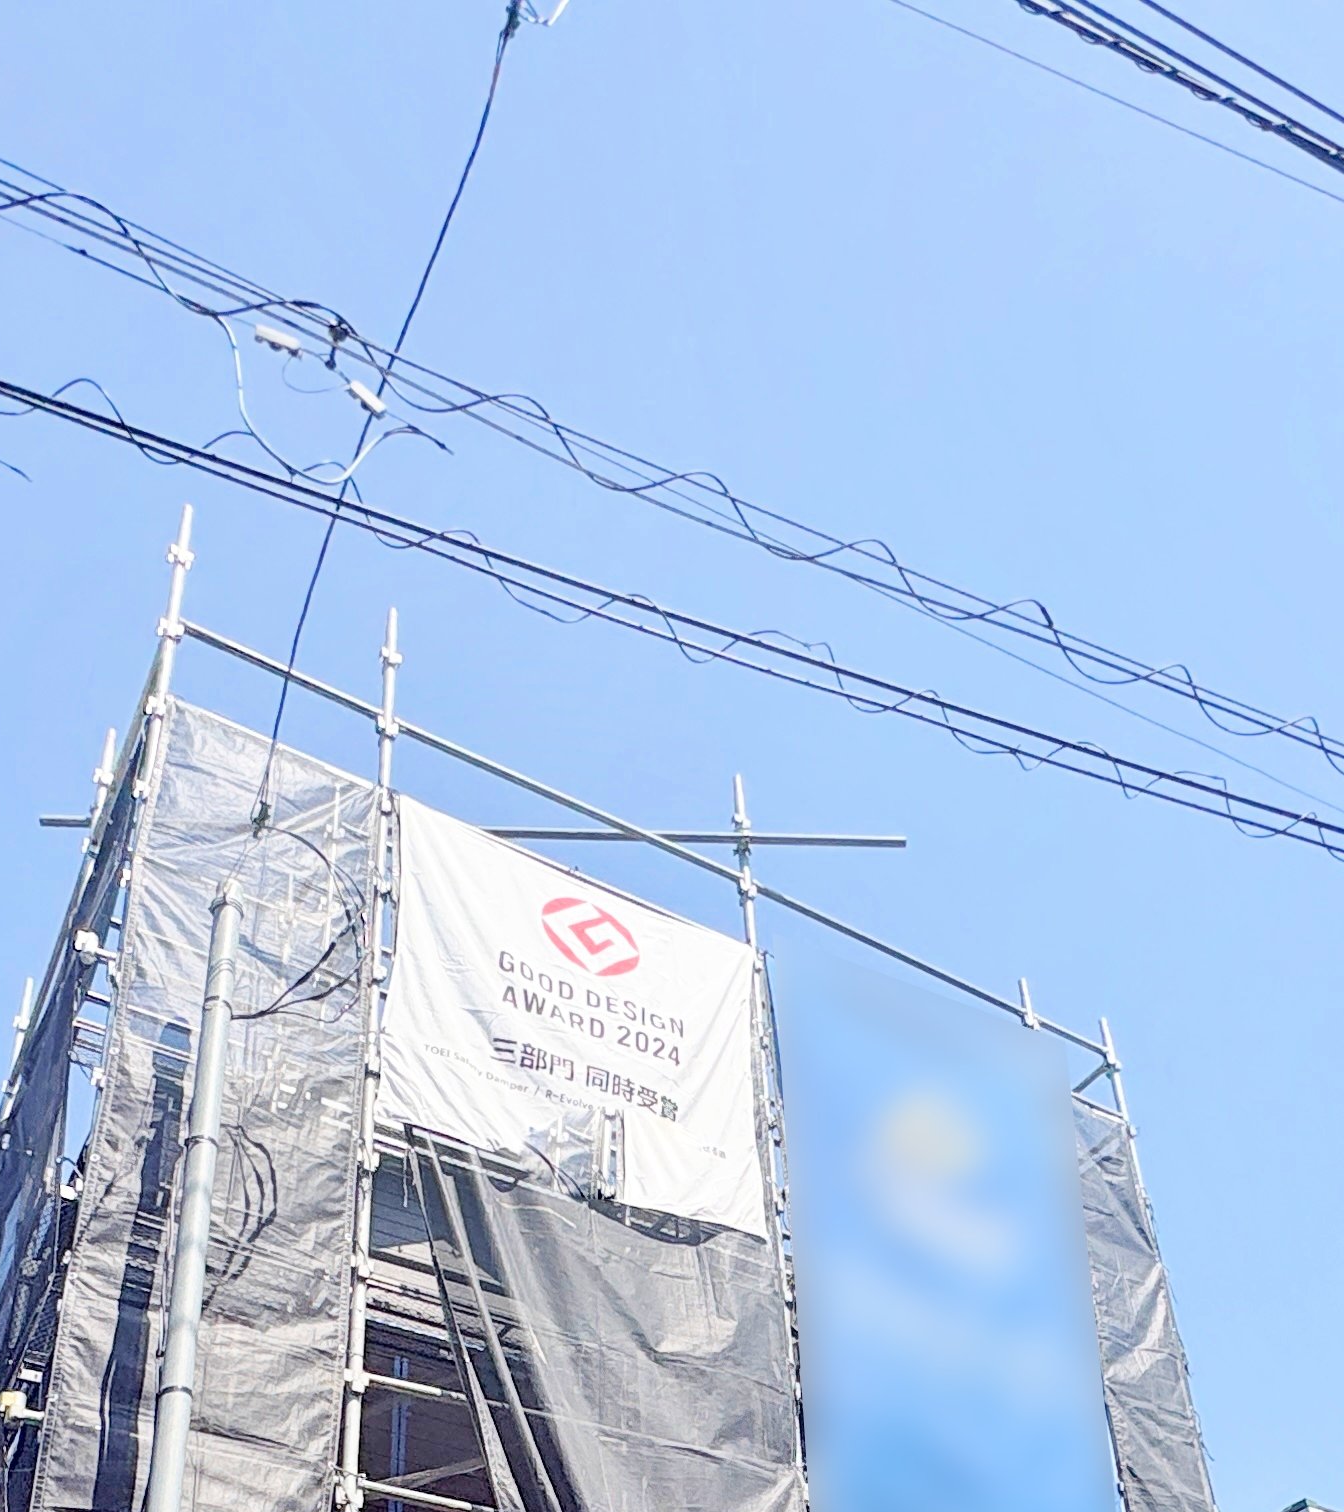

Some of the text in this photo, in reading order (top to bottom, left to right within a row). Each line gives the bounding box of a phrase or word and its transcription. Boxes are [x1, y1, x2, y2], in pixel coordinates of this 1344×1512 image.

[499, 950, 684, 1038] GOOD DESIGN
[502, 985, 681, 1067] AWARD 2024
[423, 1043, 450, 1058] TOEI
[454, 1052, 482, 1077] Say
[545, 1089, 594, 1110] R-Evolve
[490, 1037, 575, 1081] 三部門
